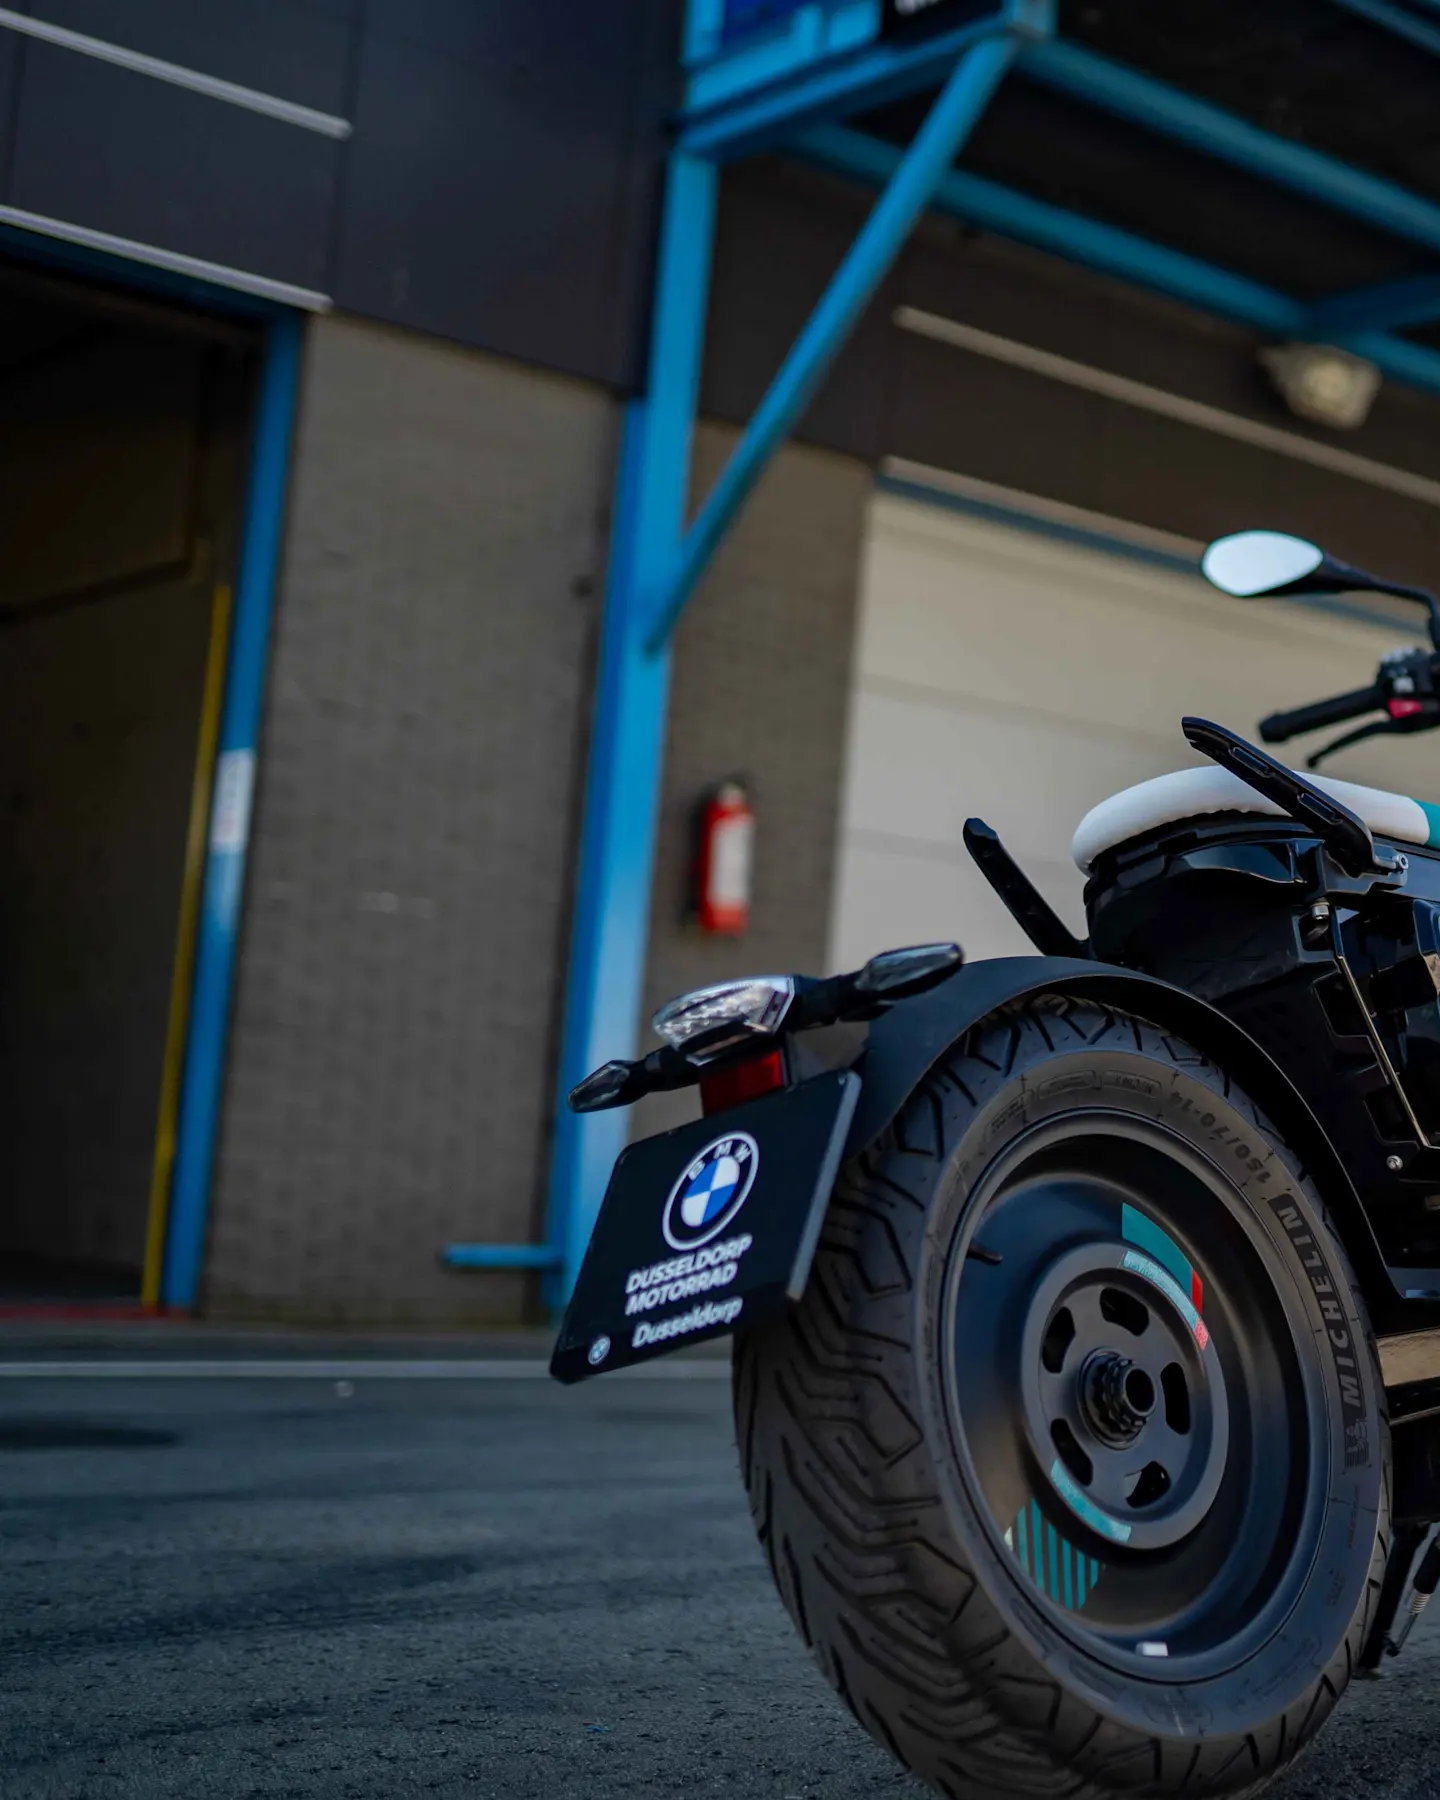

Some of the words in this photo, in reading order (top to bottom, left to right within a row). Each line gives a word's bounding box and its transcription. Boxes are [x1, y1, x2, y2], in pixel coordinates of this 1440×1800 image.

[1168, 1091, 1271, 1182] 150/70-14
[625, 1234, 753, 1293] DUSSELDORP
[625, 1263, 738, 1314] MOTORRAD
[632, 1298, 743, 1347] Dusseldorp
[1278, 1207, 1362, 1408] MICHELIN
